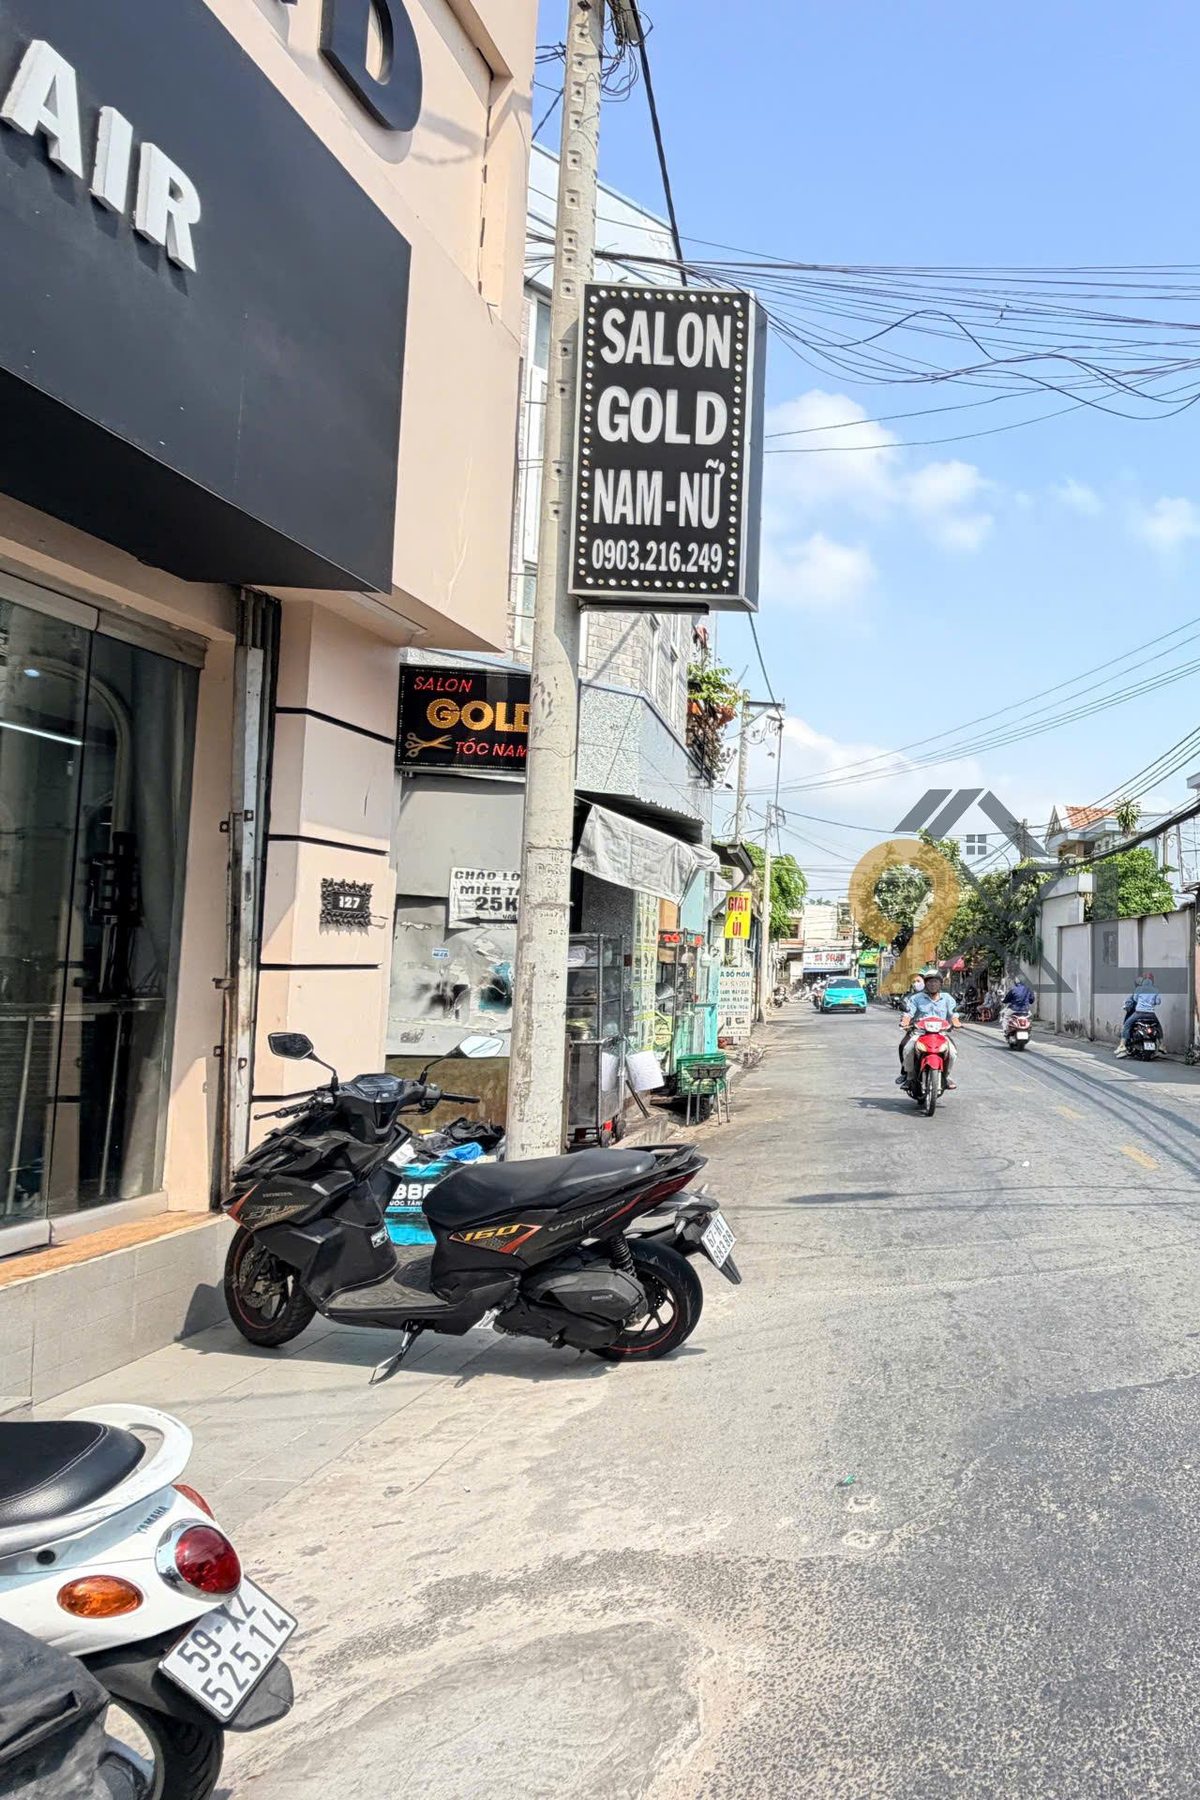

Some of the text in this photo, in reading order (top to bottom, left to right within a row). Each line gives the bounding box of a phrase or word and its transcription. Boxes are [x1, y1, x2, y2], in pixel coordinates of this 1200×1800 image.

[1, 40, 202, 273] AIR
[600, 308, 732, 369] SALON
[597, 385, 728, 446] GOLD
[592, 458, 726, 529] NAM-NỮ
[592, 538, 723, 574] 0903.216.249
[414, 676, 473, 693] SALON
[456, 737, 490, 755] TÓC
[503, 870, 520, 882] LÒ
[339, 895, 360, 909] 127
[475, 896, 518, 912] 25K
[463, 1224, 521, 1242] 160
[136, 1505, 170, 1534] YAMAHA
[200, 1608, 291, 1710] 525.14
